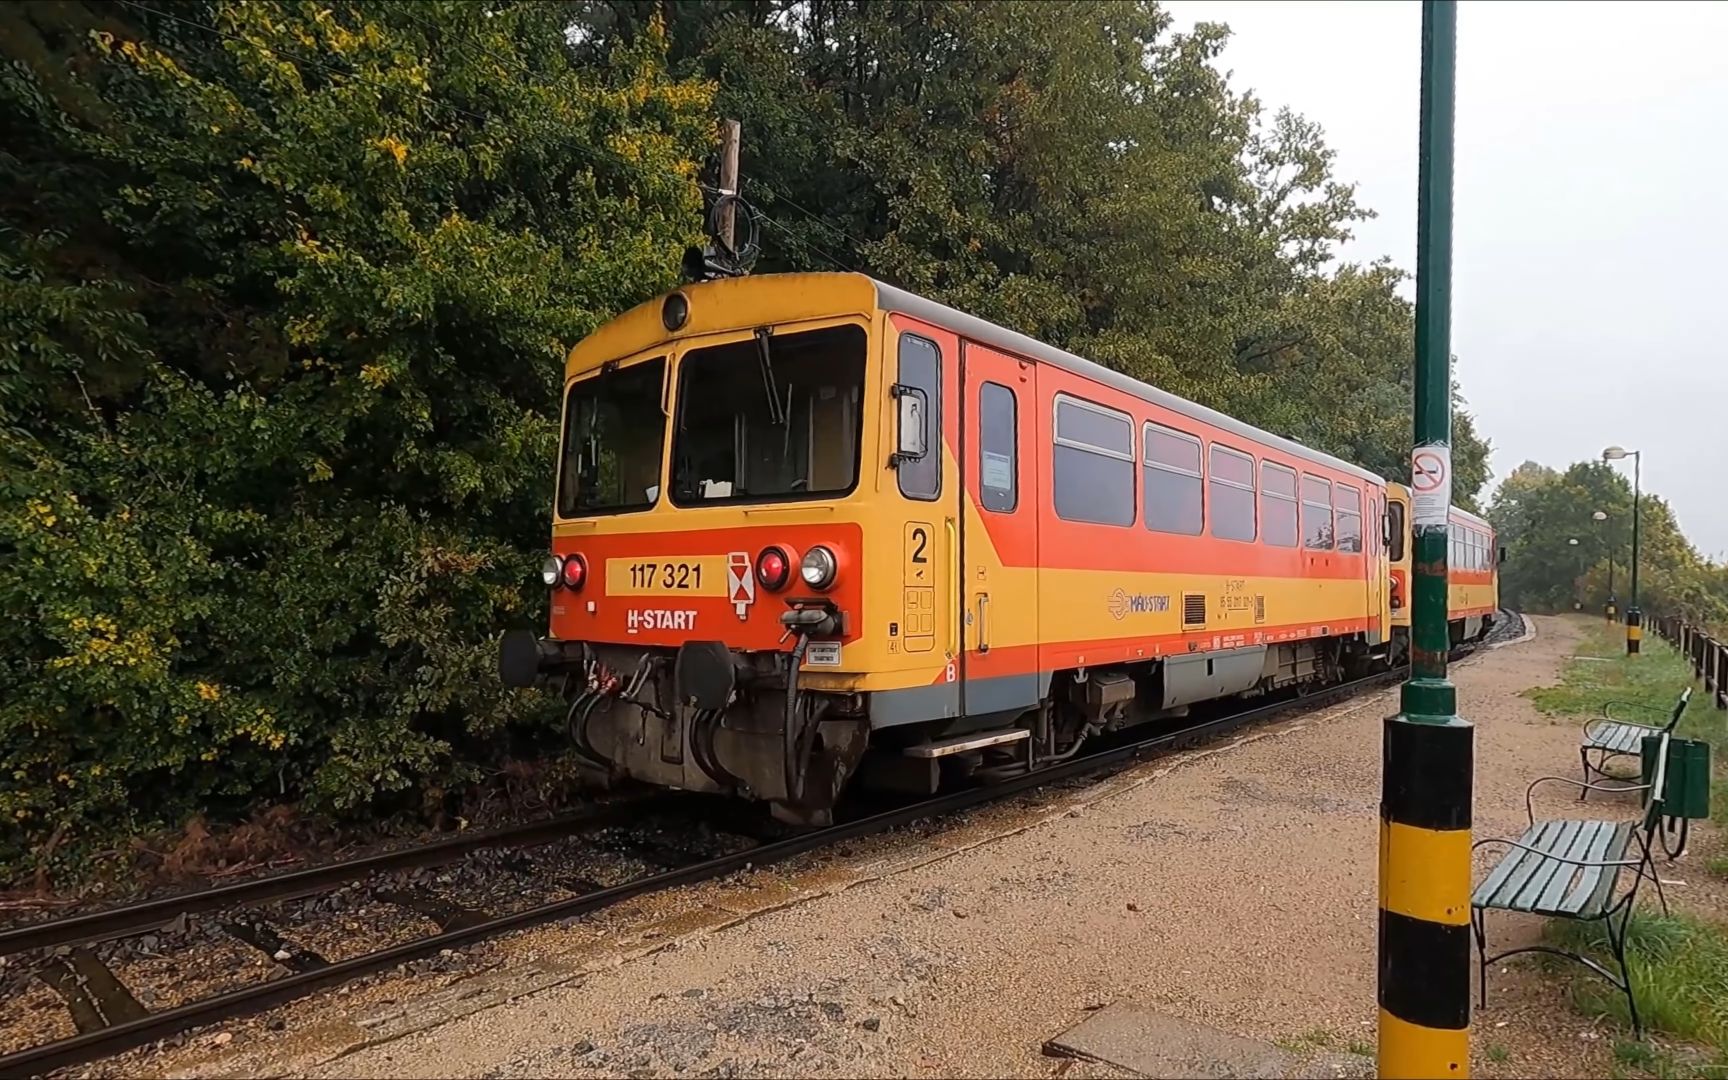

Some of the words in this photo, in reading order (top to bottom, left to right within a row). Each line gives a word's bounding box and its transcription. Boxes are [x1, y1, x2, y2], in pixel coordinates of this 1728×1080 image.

[912, 528, 927, 563] 2
[630, 564, 657, 588] 117
[663, 564, 701, 588] 321
[627, 609, 698, 634] H-START
[947, 664, 955, 681] B
